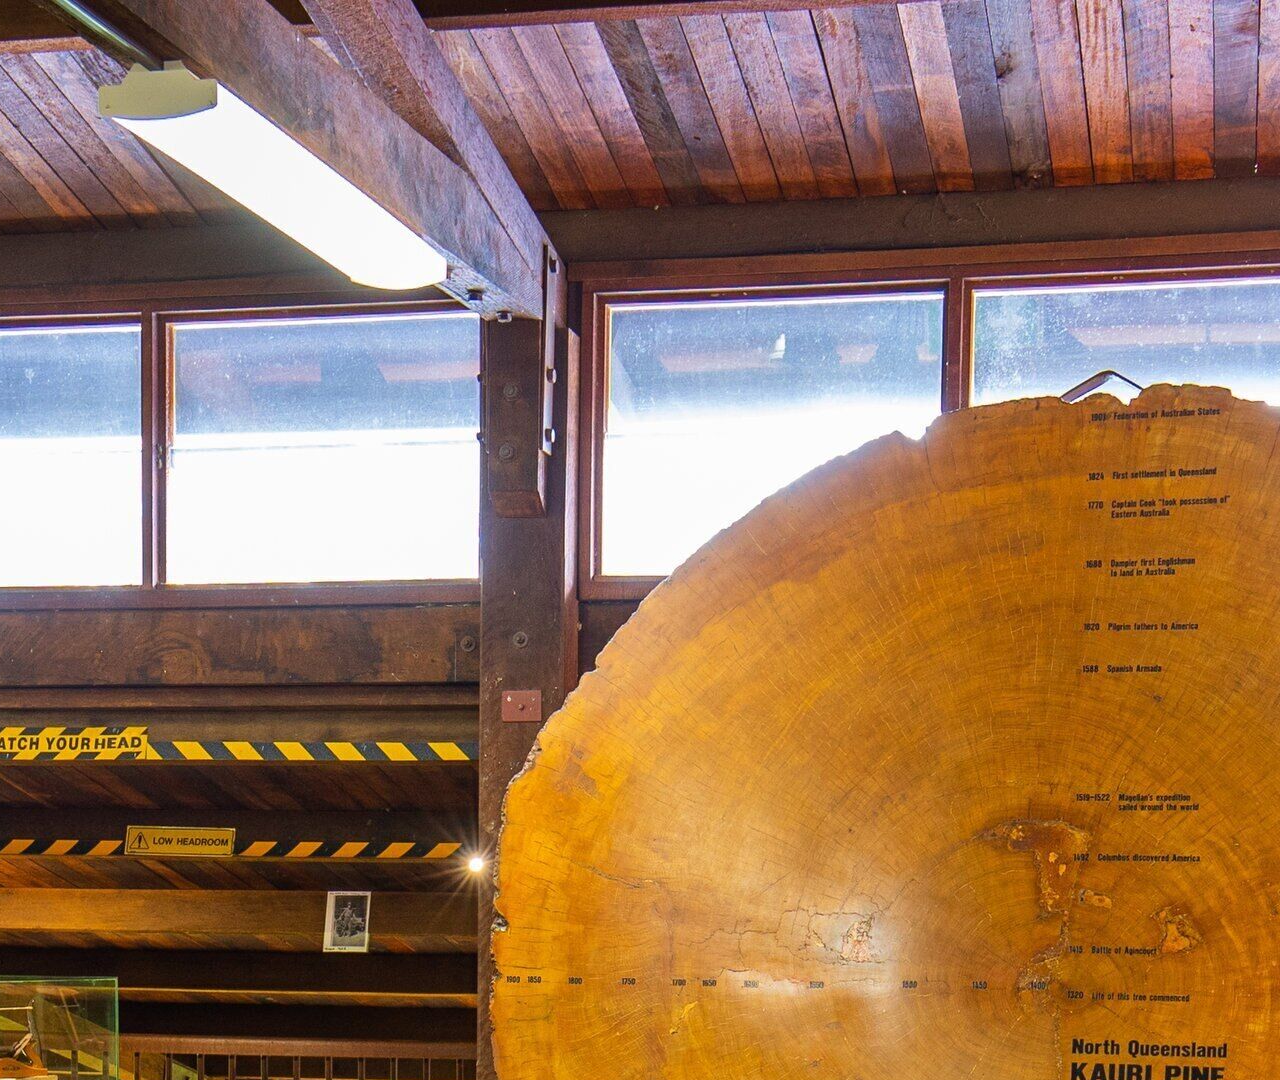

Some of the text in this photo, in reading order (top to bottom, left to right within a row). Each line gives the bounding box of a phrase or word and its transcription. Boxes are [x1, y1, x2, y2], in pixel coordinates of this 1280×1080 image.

[1114, 411, 1148, 420] Federation
[1151, 410, 1158, 418] of
[1161, 409, 1195, 418] Australian
[1113, 471, 1128, 479] First
[1131, 469, 1167, 478] settlement
[1179, 467, 1216, 476] Queensland
[1088, 501, 1103, 509] 1770
[1112, 500, 1136, 509] Captain
[1140, 499, 1156, 507] Cook
[1180, 496, 1217, 506] possession
[1111, 508, 1169, 518] Eastern Australia
[1111, 559, 1138, 568] Dampier
[1158, 557, 1195, 567] Englishman
[1111, 569, 1117, 577] to
[1136, 568, 1142, 576] in
[1145, 568, 1175, 576] Australia
[1084, 623, 1099, 631] 1620
[1108, 623, 1131, 632] Pilgrim
[1134, 623, 1158, 631] fathers
[1171, 622, 1198, 630] America
[1083, 665, 1098, 673] 1588
[1107, 665, 1133, 673] Spanish
[46, 737, 90, 750] YOUR
[94, 736, 142, 749] HEAD
[1118, 794, 1153, 802] Magellan's
[1156, 794, 1190, 802] expedition
[153, 836, 229, 847] LOW HEADROOM
[1172, 854, 1200, 862] America
[1091, 946, 1111, 954] Battle
[1125, 947, 1157, 955] Agincourt
[1067, 991, 1084, 999] 1320
[1118, 993, 1129, 1001] this
[1149, 994, 1190, 1002] commenced
[1072, 1039, 1227, 1058] North Queensland
